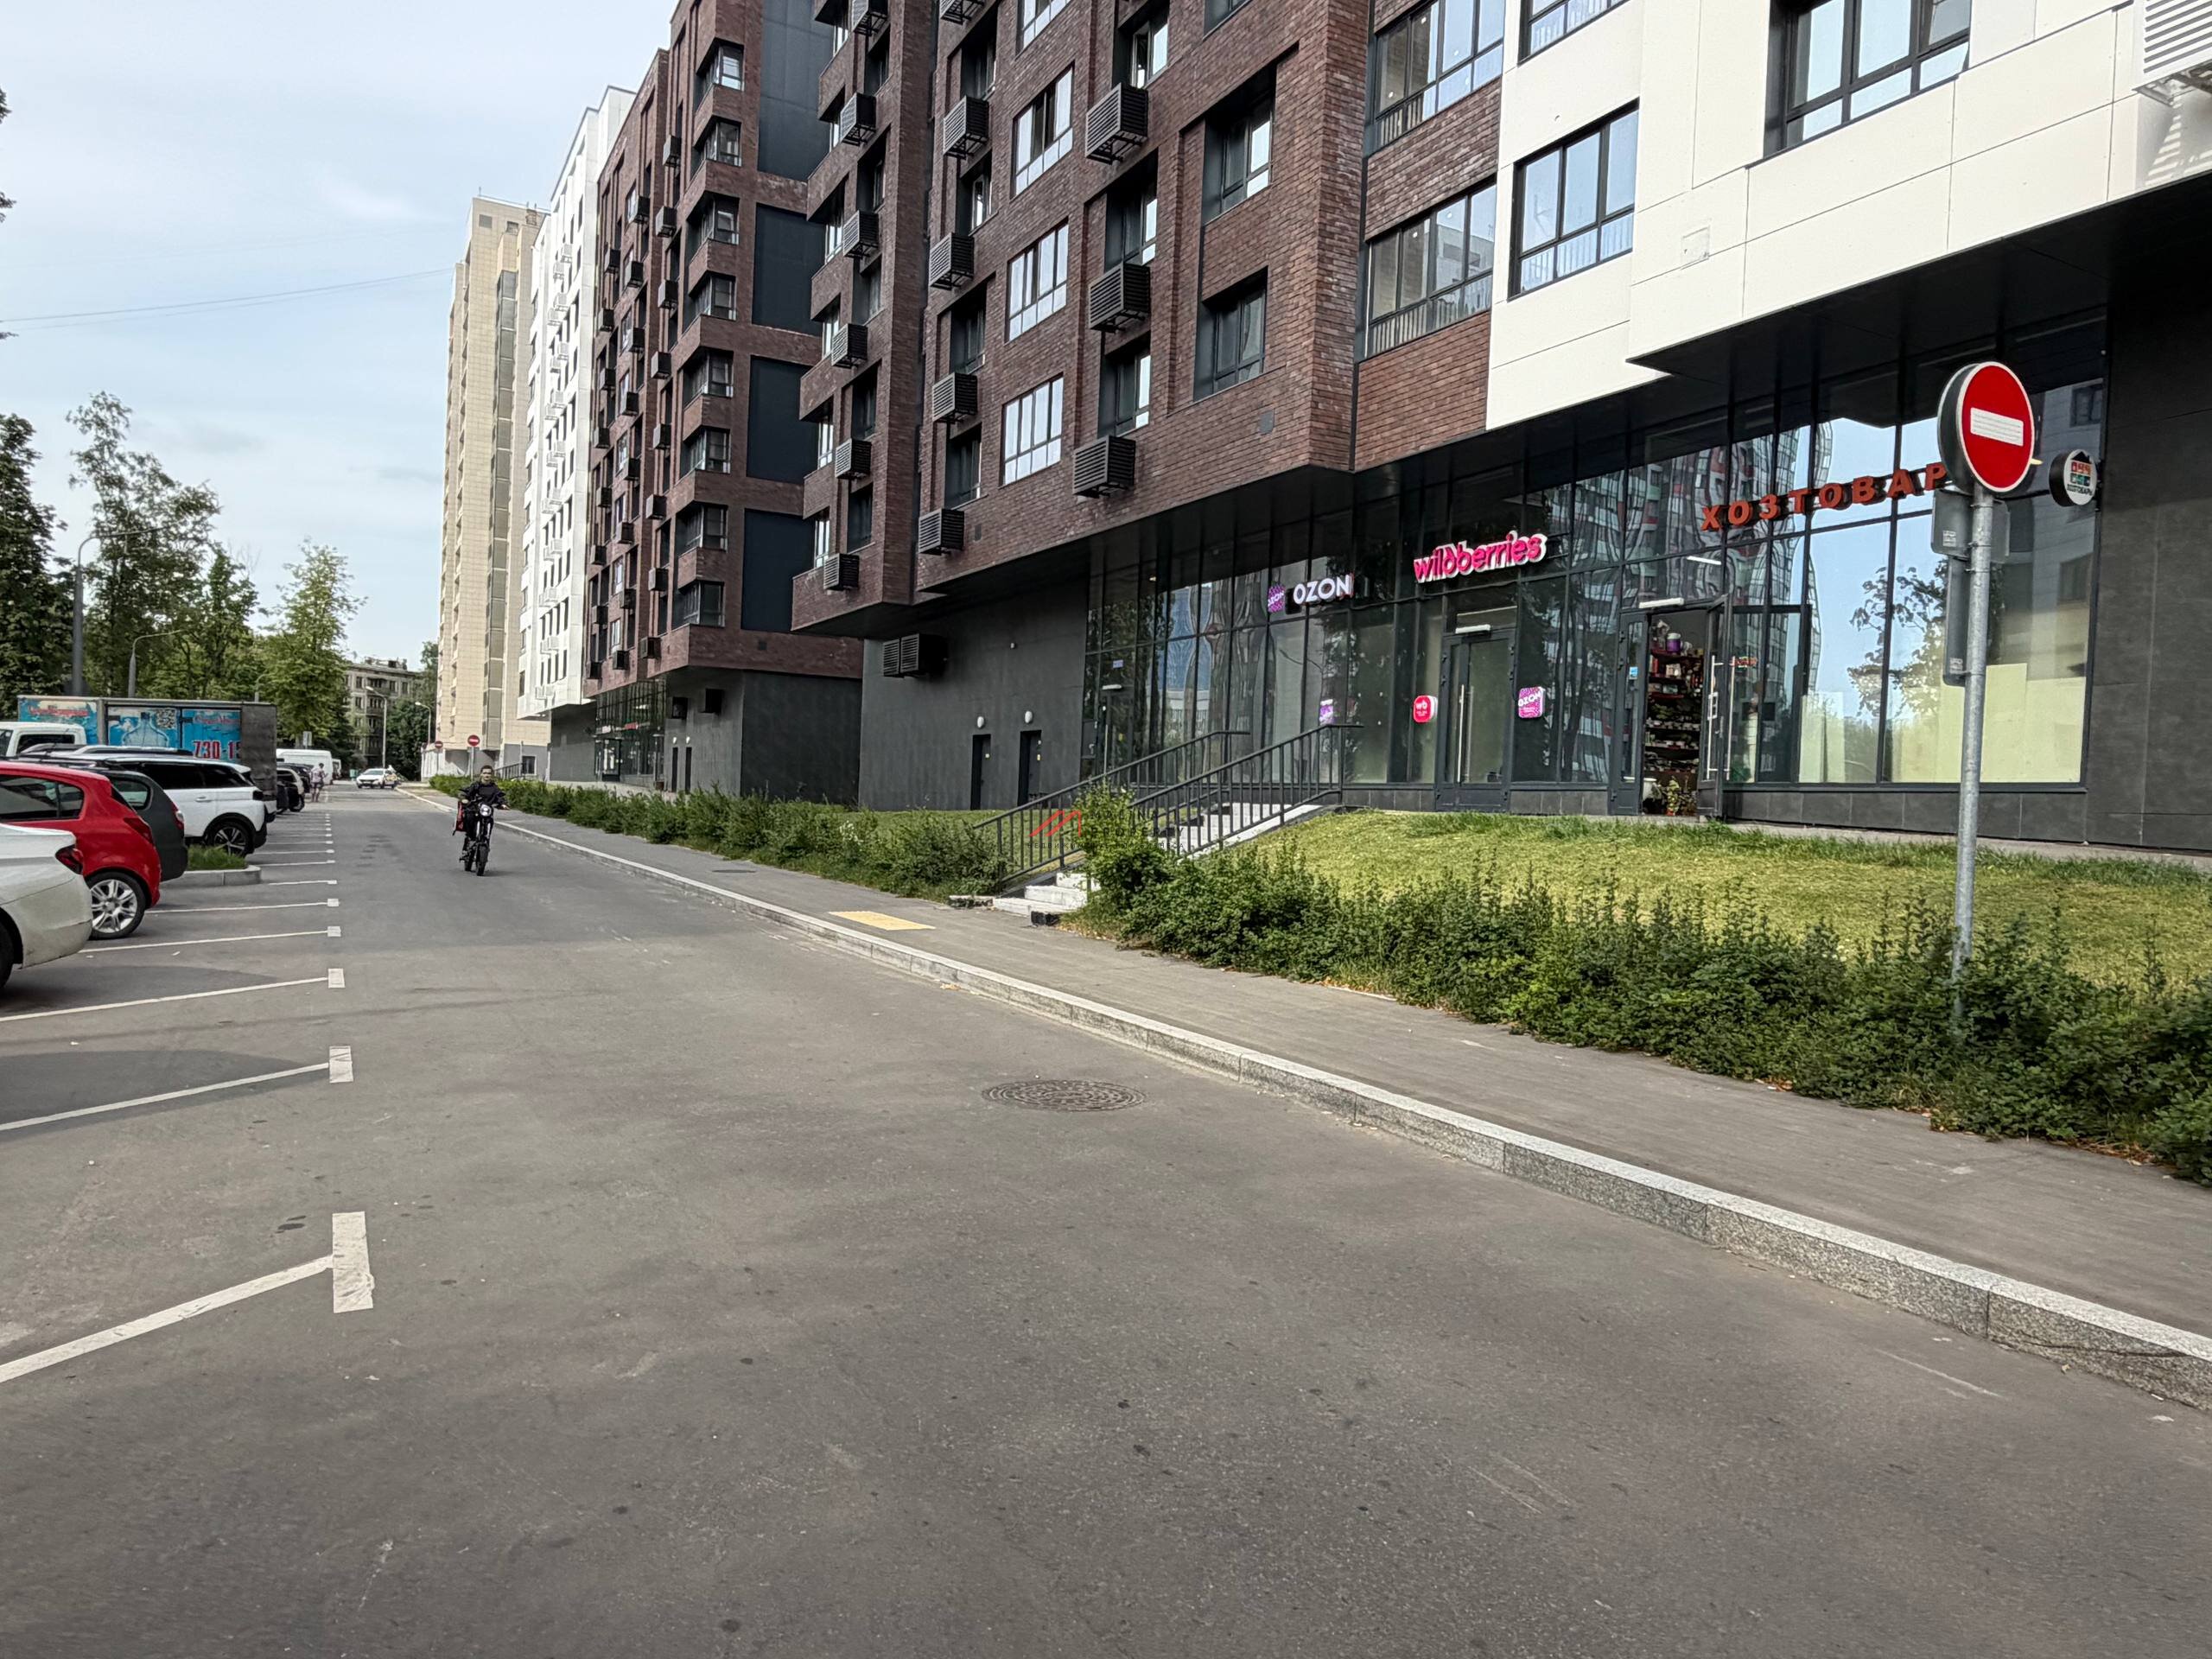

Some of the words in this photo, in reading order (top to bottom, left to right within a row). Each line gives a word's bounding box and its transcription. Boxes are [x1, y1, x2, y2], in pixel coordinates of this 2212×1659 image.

[1701, 462, 1947, 531] ХОЗТОВАР
[1414, 531, 1548, 583] wildberries
[1293, 574, 1352, 605] OZON
